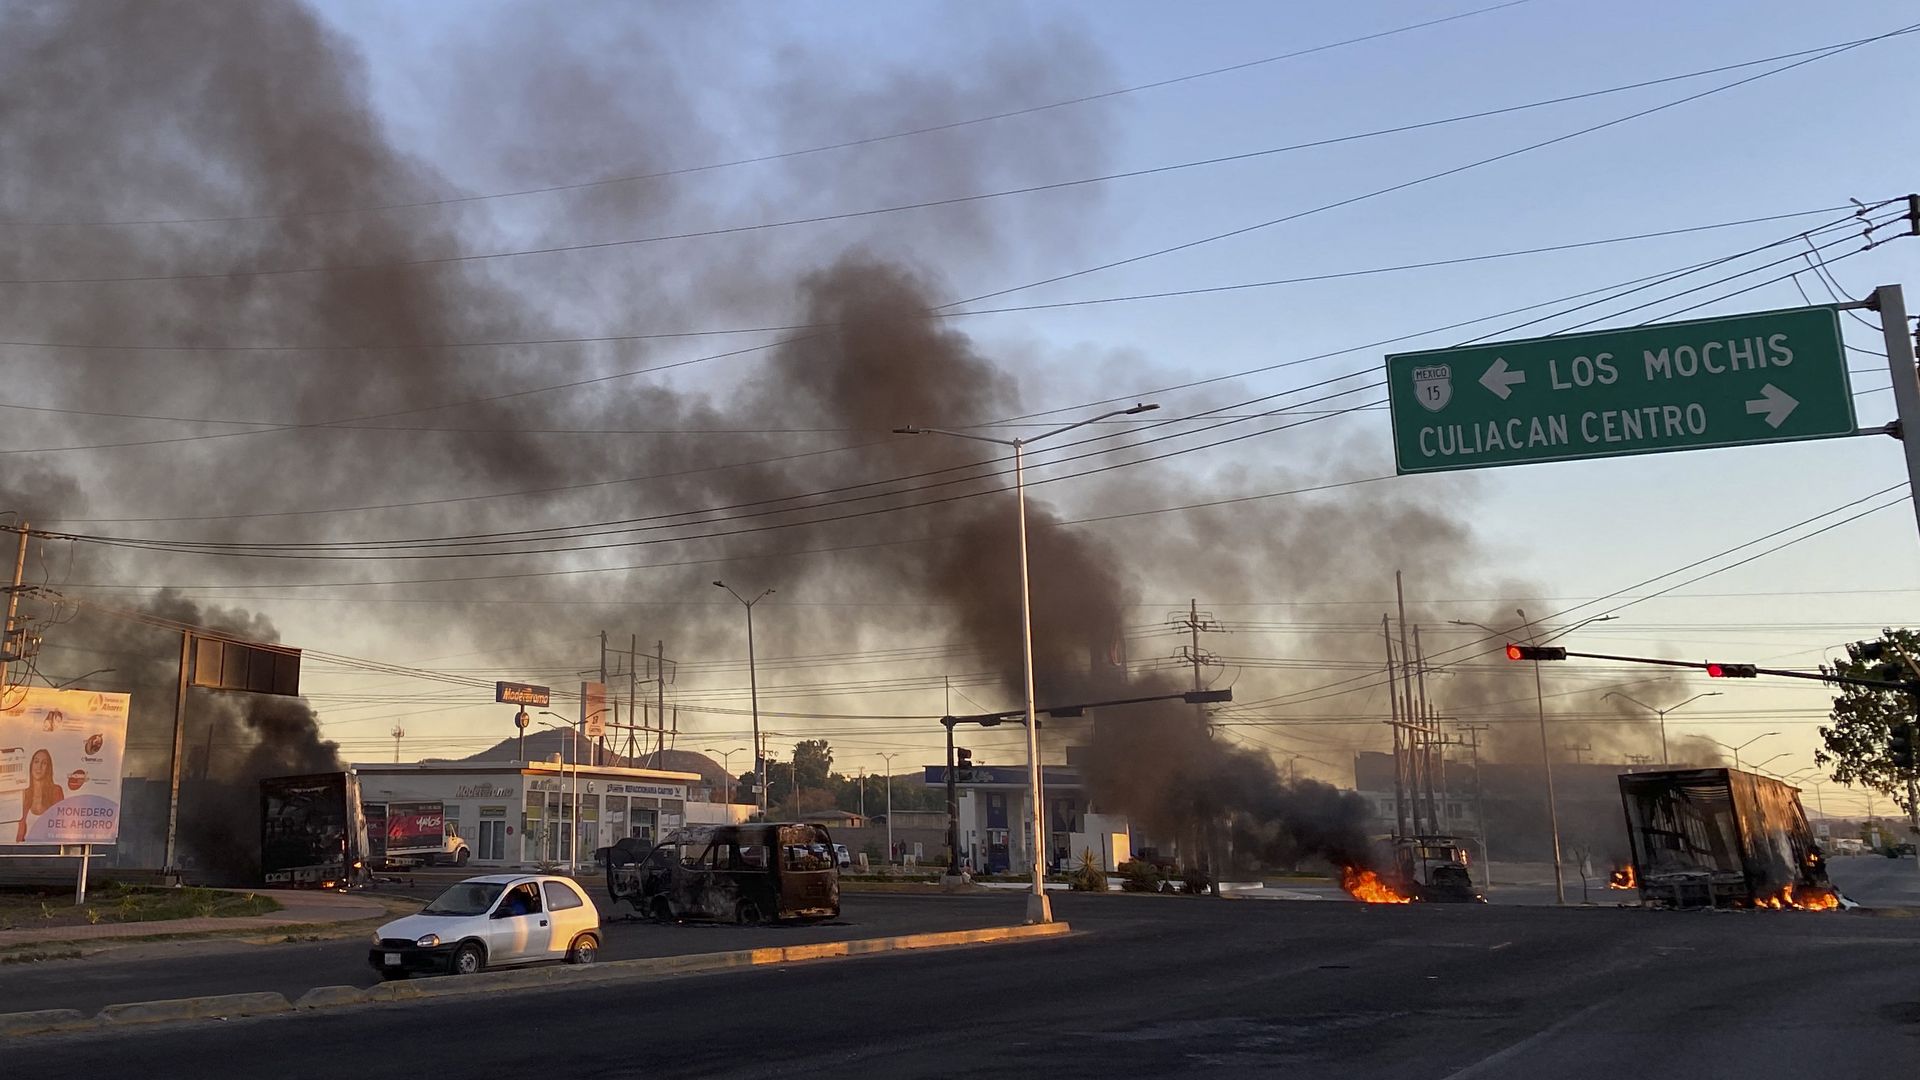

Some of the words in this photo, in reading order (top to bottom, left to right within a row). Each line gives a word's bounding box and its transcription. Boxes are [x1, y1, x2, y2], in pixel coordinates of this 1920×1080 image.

[1549, 352, 1619, 390] LOS
[1643, 333, 1794, 381] MOCHIS
[1416, 367, 1447, 379] MEXICO
[1427, 385, 1440, 401] 15
[1419, 414, 1569, 457] CULIACAN
[1581, 403, 1707, 443] CENTRO
[57, 806, 114, 817] MONEDERO
[47, 819, 66, 829] DEL
[70, 820, 113, 830] AHORRO
